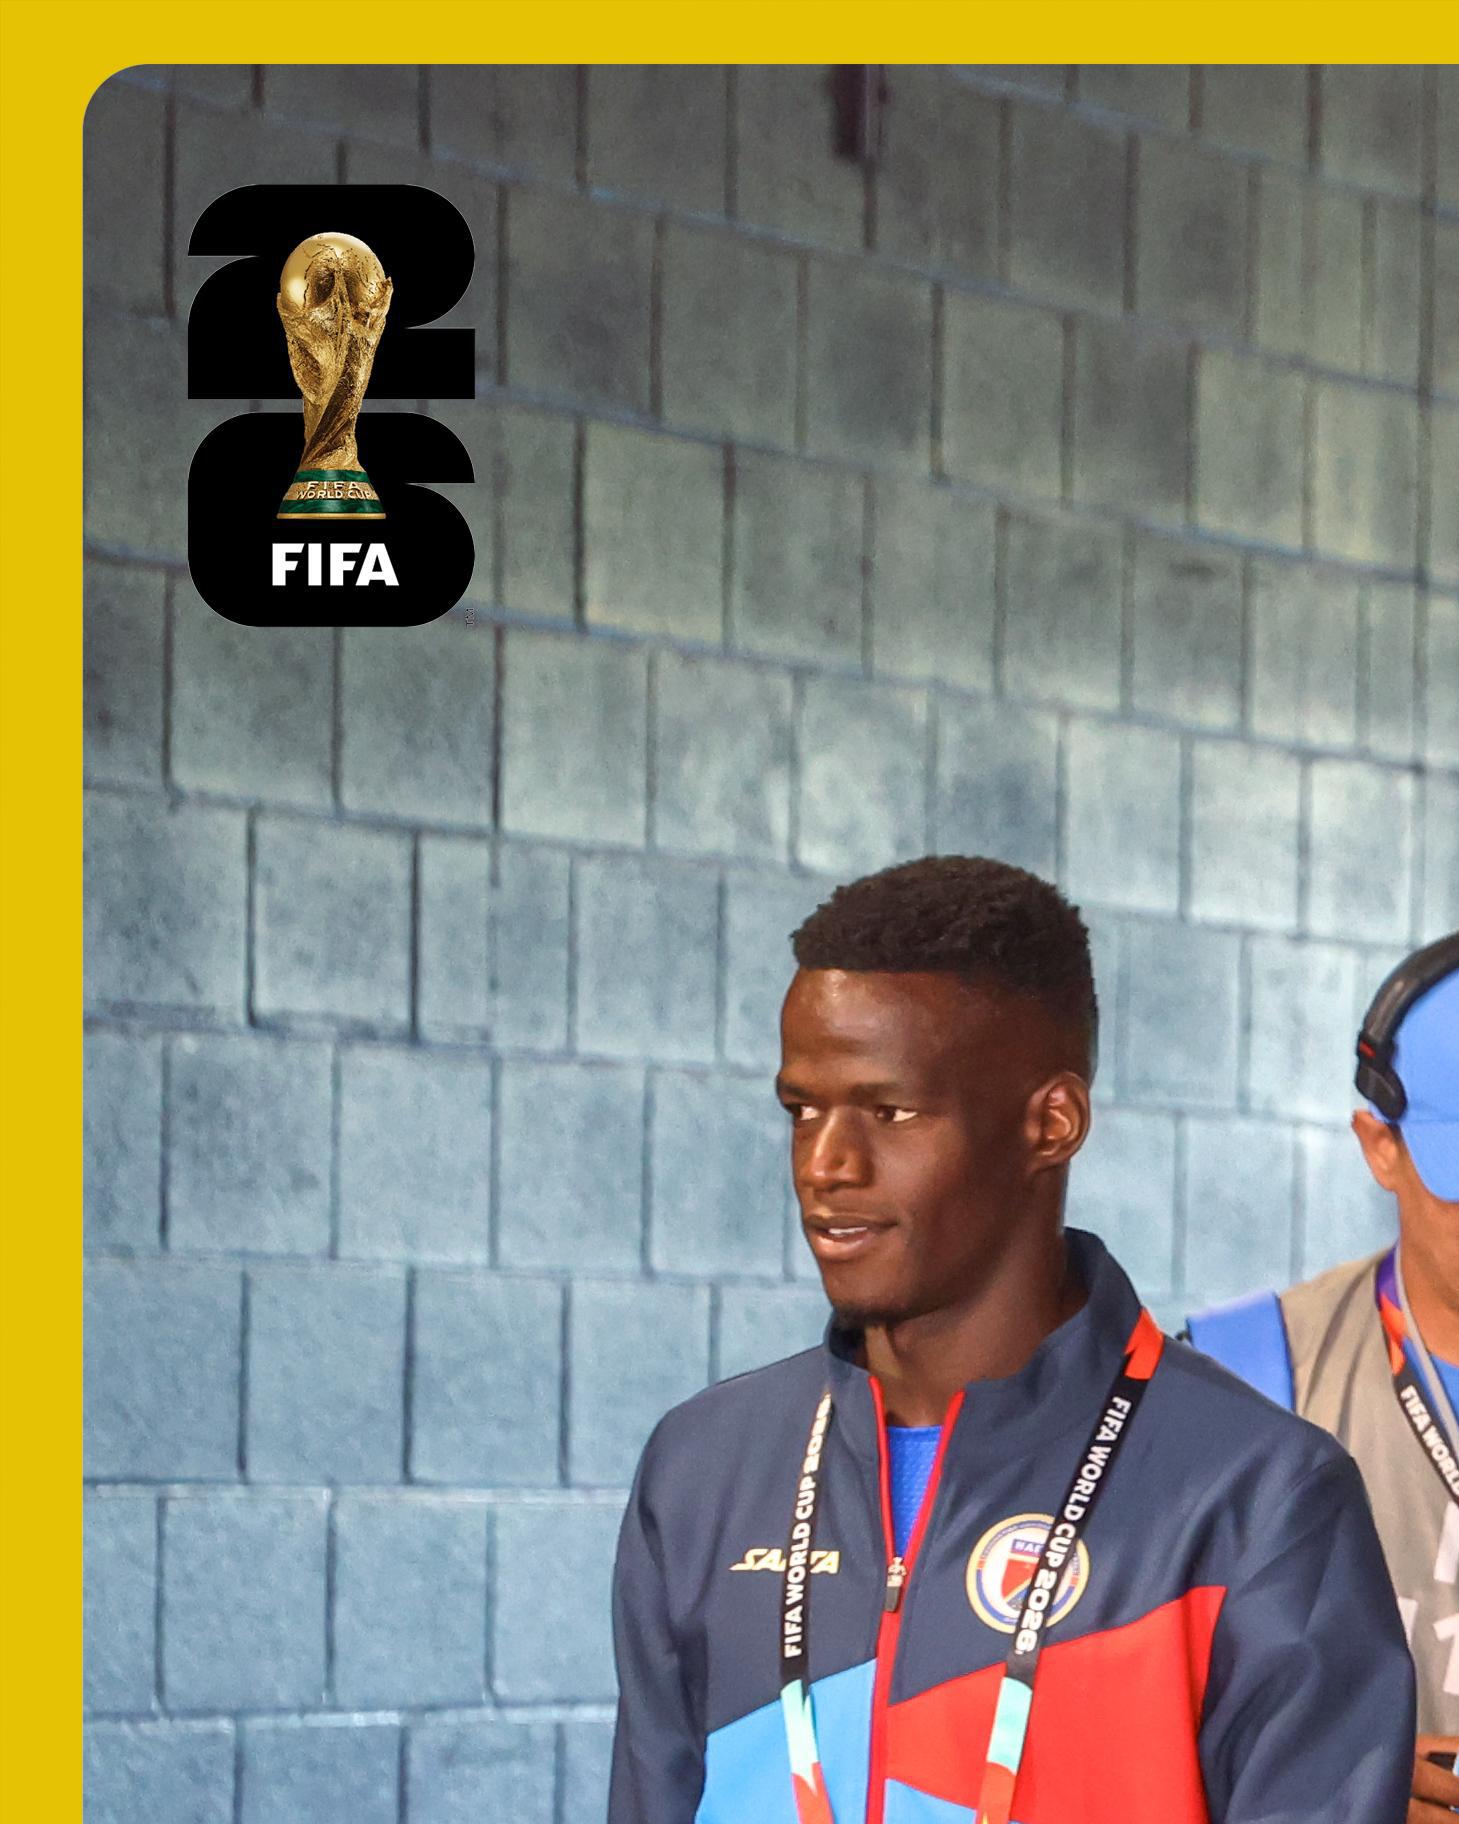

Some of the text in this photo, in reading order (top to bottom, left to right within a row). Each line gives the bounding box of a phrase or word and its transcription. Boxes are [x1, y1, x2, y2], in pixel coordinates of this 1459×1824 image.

[1096, 1395, 1132, 1442] FIFA
[1401, 1385, 1432, 1431] FIFA
[795, 1475, 817, 1521] CUP
[1063, 1445, 1112, 1522] WORLD
[729, 1549, 840, 1575] SATA
[786, 1522, 812, 1605] WORLD
[1045, 1522, 1077, 1569] CUP
[784, 1605, 803, 1658] FIFA
[1015, 1568, 1058, 1655] 2026
